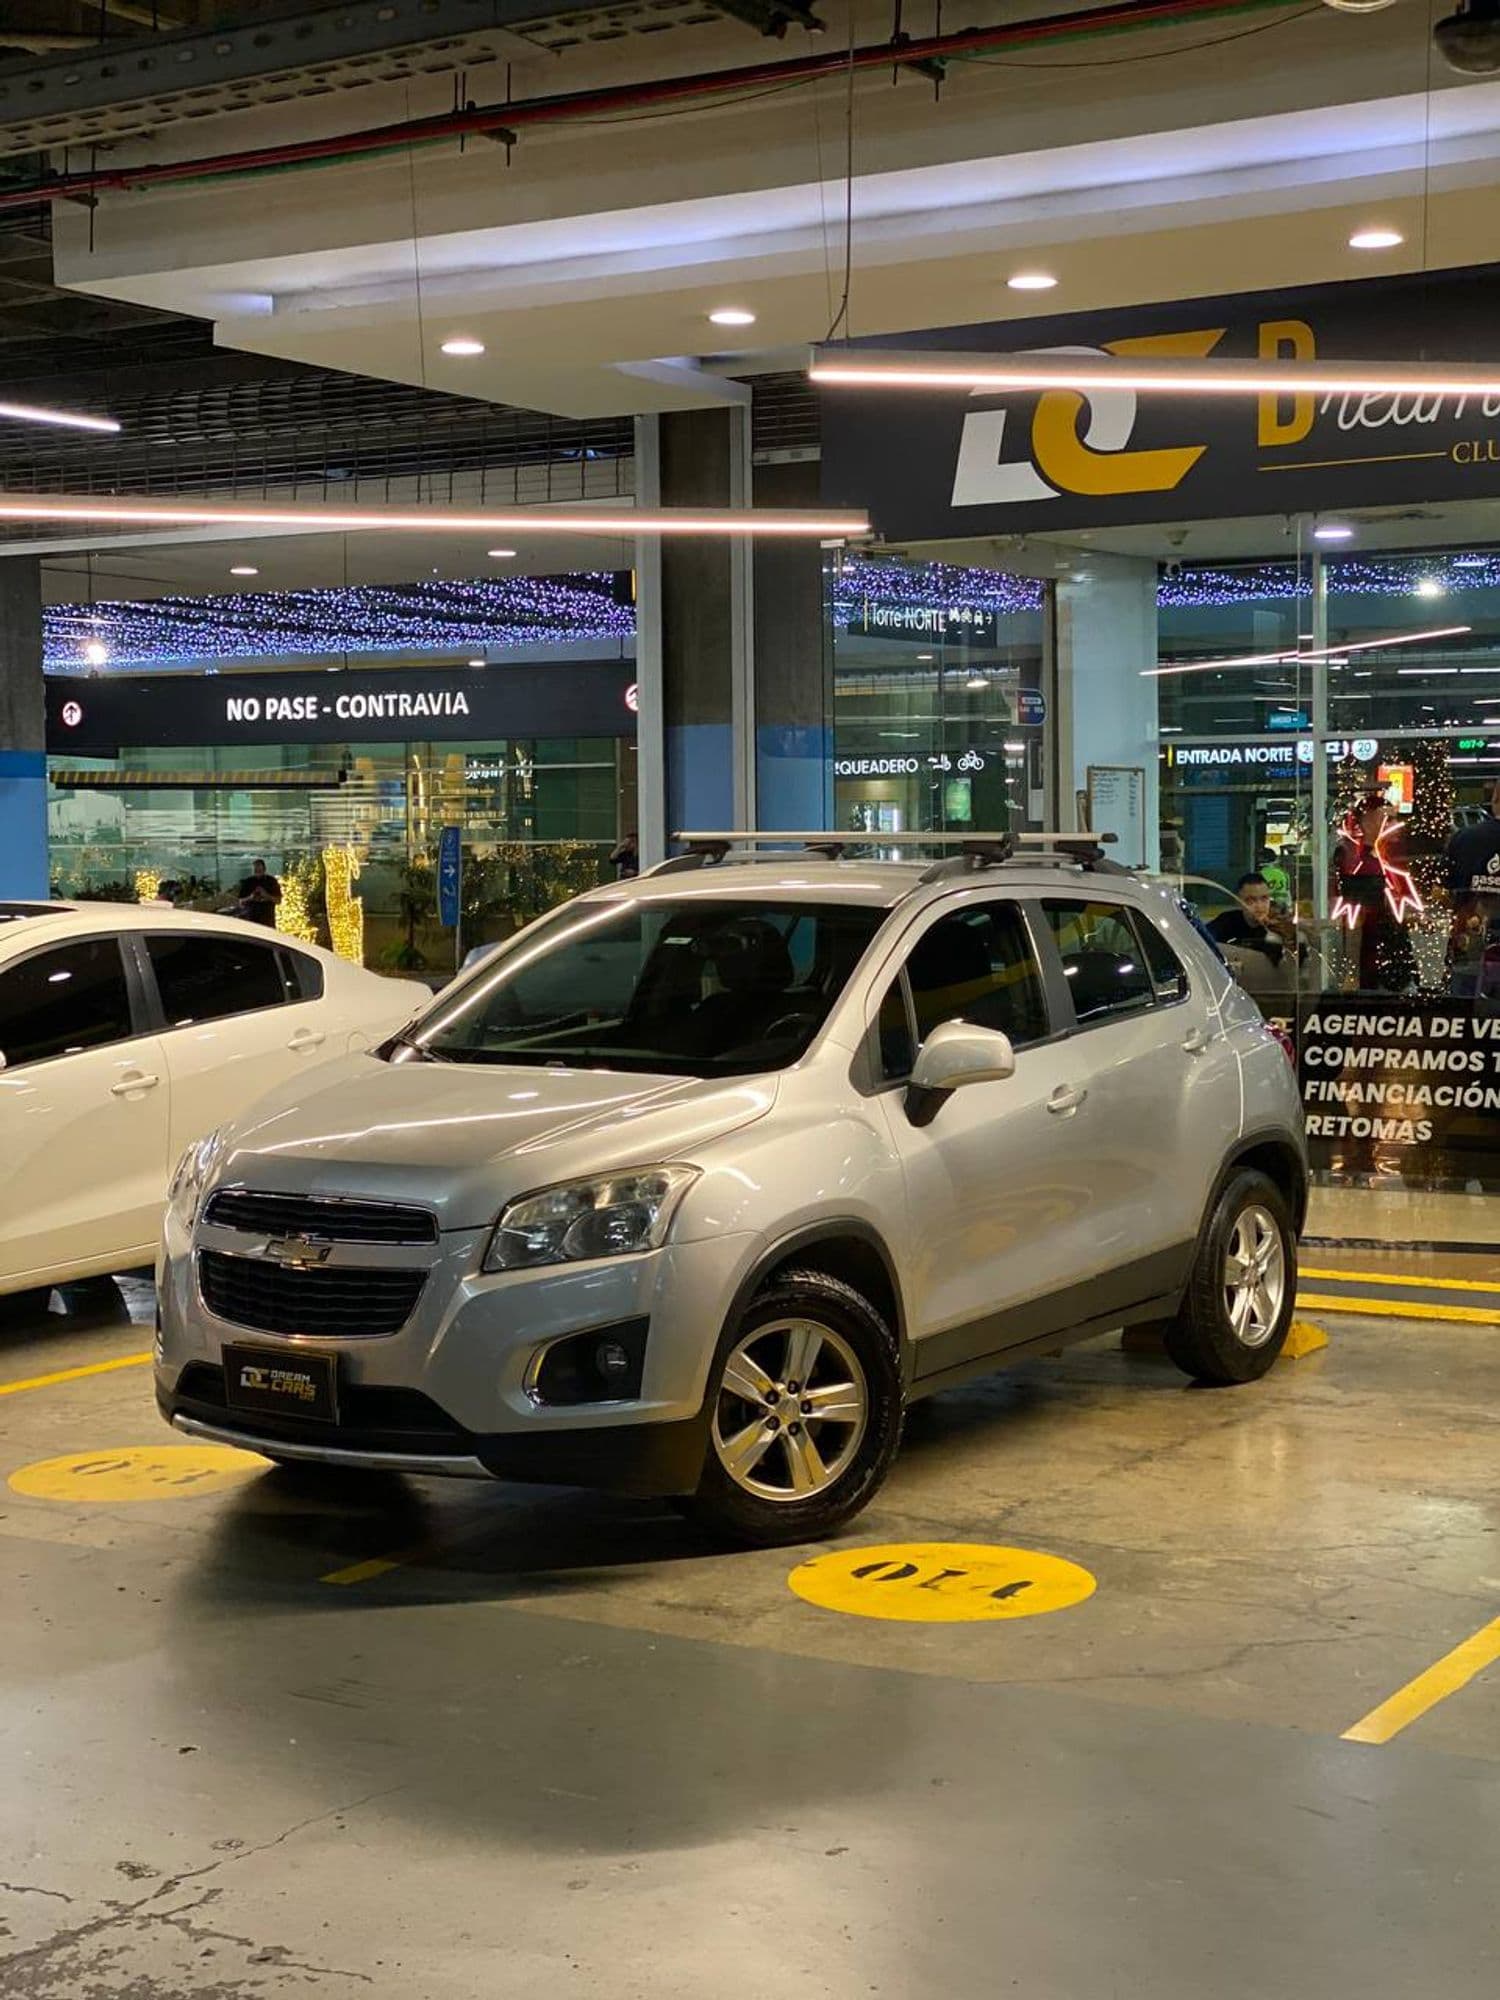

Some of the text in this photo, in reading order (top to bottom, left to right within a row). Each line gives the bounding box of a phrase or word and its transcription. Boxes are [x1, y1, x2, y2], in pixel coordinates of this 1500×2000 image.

[871, 602, 947, 632] Torre NORTE
[226, 698, 259, 721] NO
[265, 696, 318, 720] PASE
[335, 691, 469, 718] CONTRAVIA
[1176, 747, 1242, 764] ENTRADA
[1245, 746, 1293, 763] NORTE
[1303, 1013, 1423, 1037] AGENCIA
[1429, 1017, 1465, 1038] DE
[1304, 1046, 1486, 1072] COMPRAMOS
[1305, 1115, 1433, 1142] RETOMAS
[270, 1369, 311, 1384] DREAM
[271, 1379, 317, 1396] CARS
